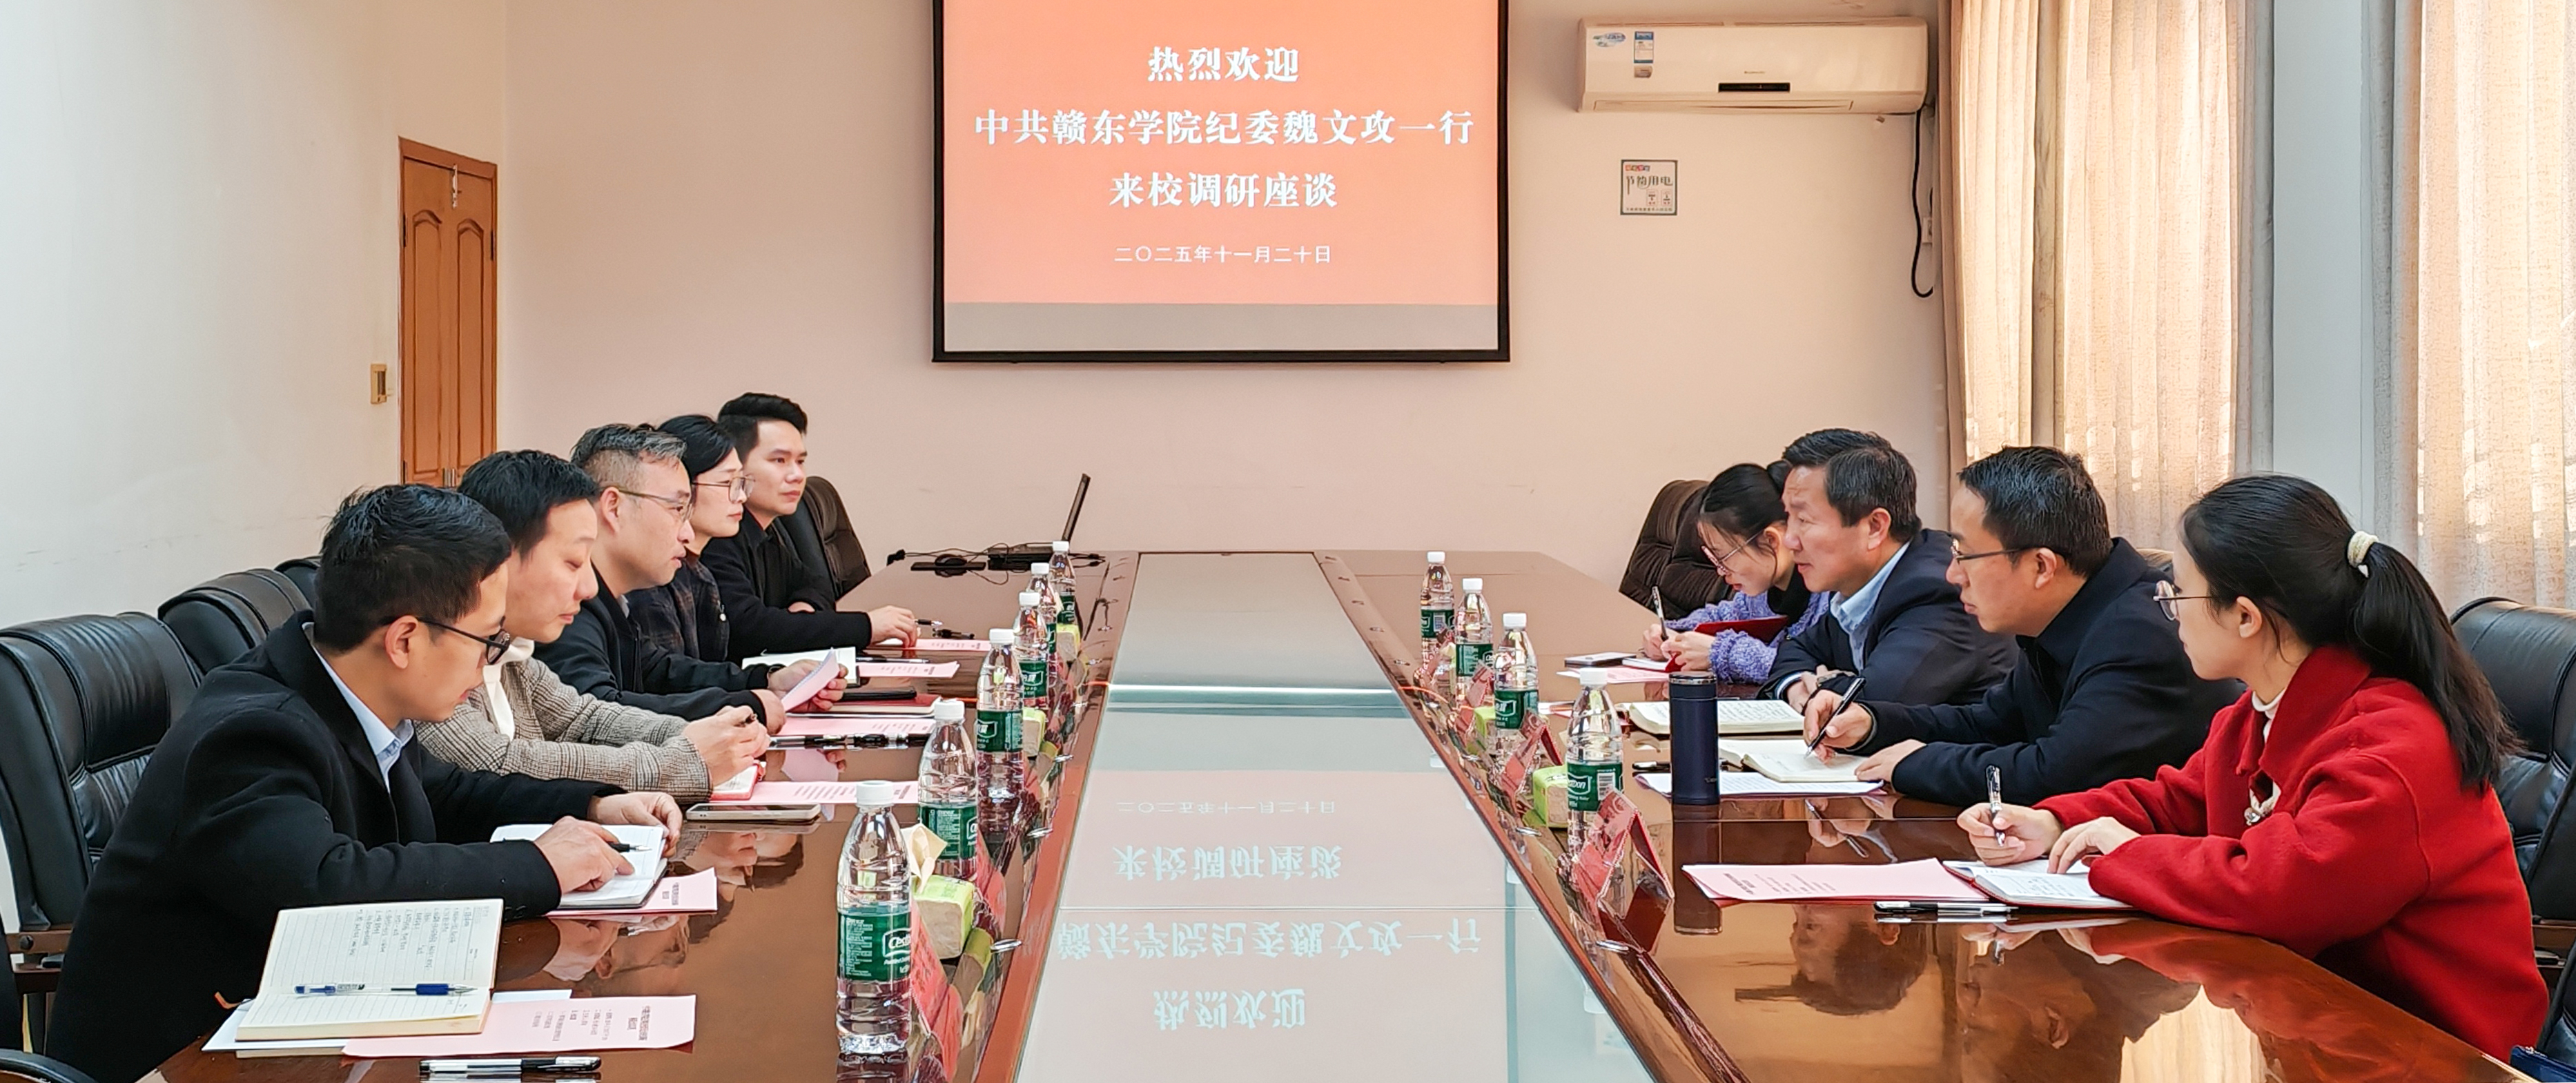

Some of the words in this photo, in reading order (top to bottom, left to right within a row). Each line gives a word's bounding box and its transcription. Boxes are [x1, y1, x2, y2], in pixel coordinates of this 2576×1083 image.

[1146, 45, 1300, 84] 热烈欢迎
[974, 108, 1475, 146] 中共赣东学院纪委魏文攻一行
[1109, 170, 1338, 210] 来校调研座谈
